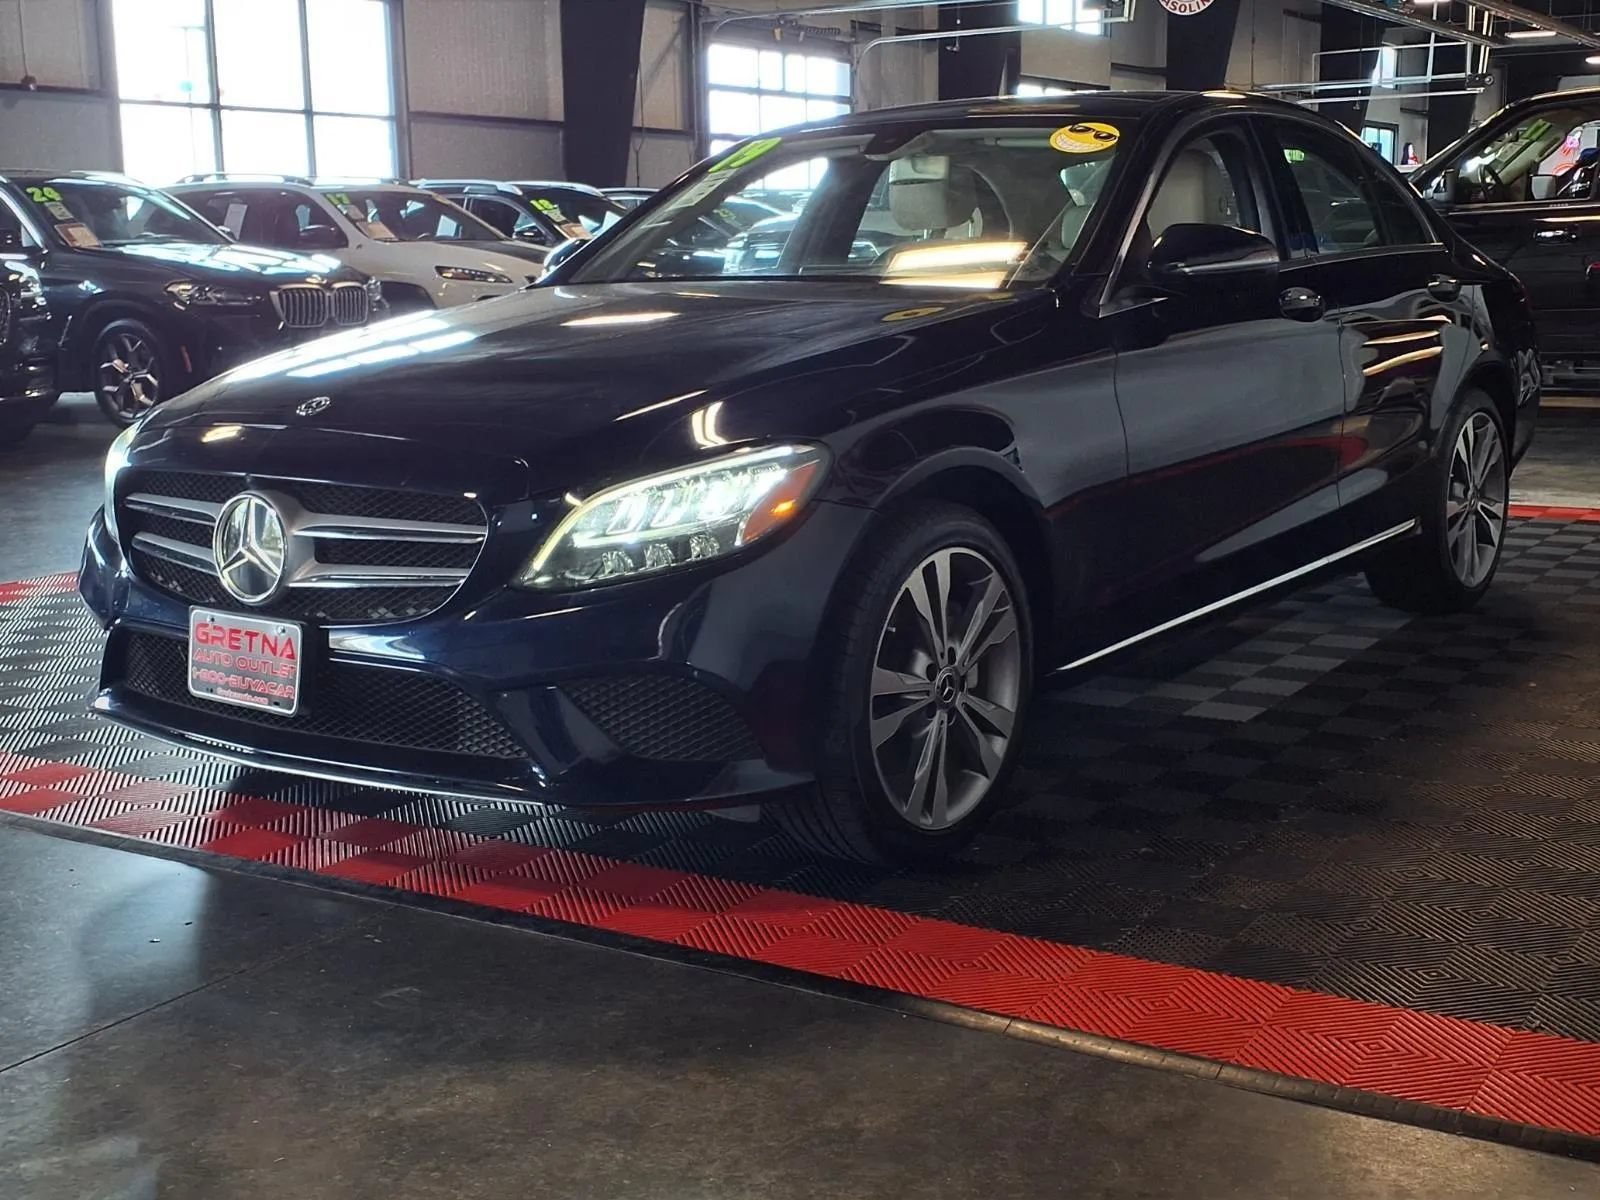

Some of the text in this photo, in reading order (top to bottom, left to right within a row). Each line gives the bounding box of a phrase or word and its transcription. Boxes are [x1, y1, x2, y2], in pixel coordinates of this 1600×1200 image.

[195, 622, 296, 660] GRETNA
[193, 648, 296, 679] AUTO OUTLET
